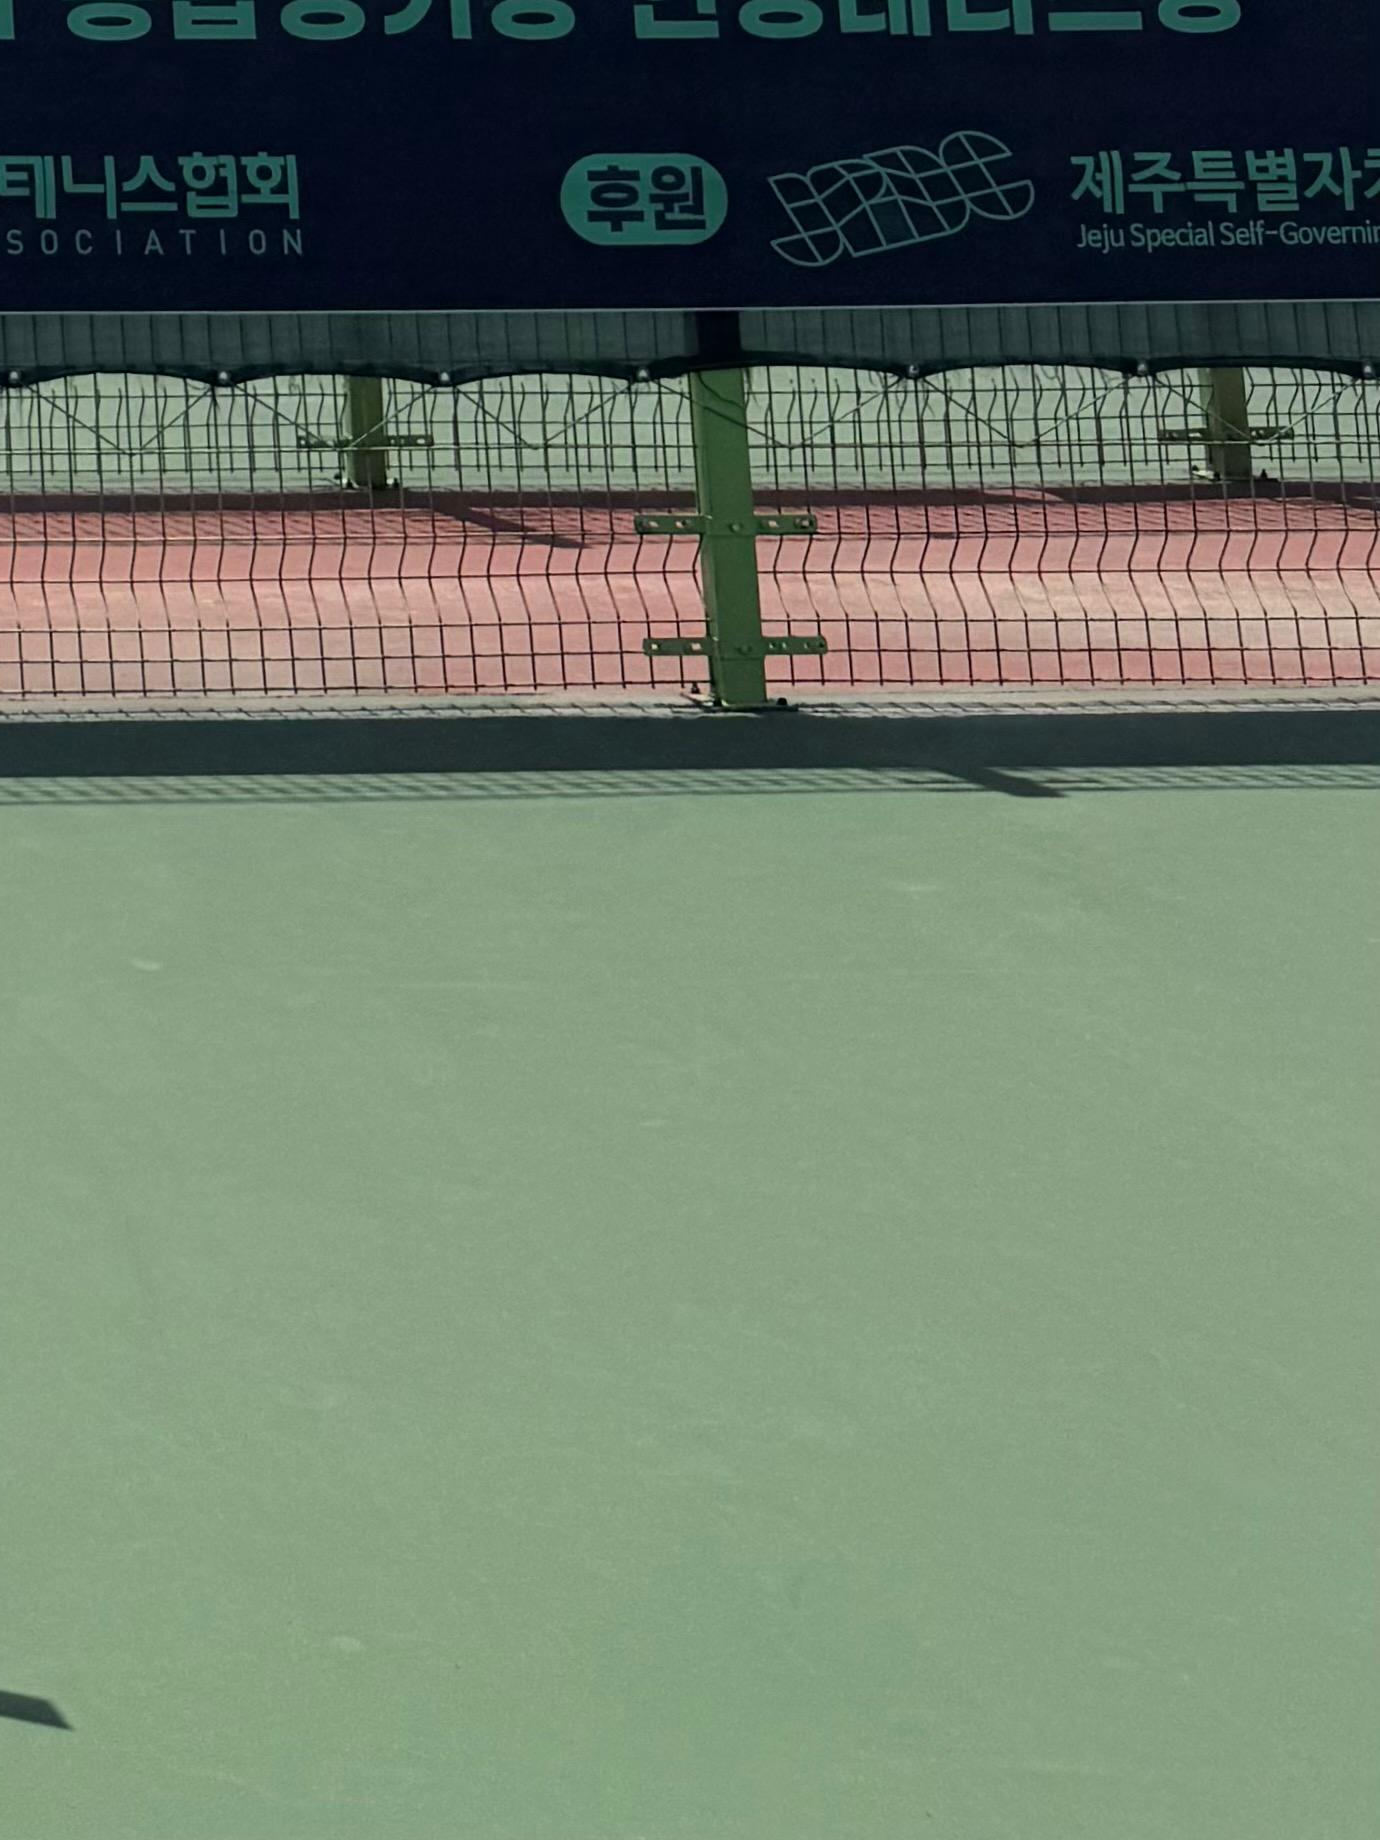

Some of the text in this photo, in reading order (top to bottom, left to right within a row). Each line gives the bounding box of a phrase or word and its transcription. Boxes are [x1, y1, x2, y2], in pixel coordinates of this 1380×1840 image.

[586, 160, 707, 233] 후원
[1076, 223, 1125, 254] Jeju
[1129, 221, 1215, 253] Special
